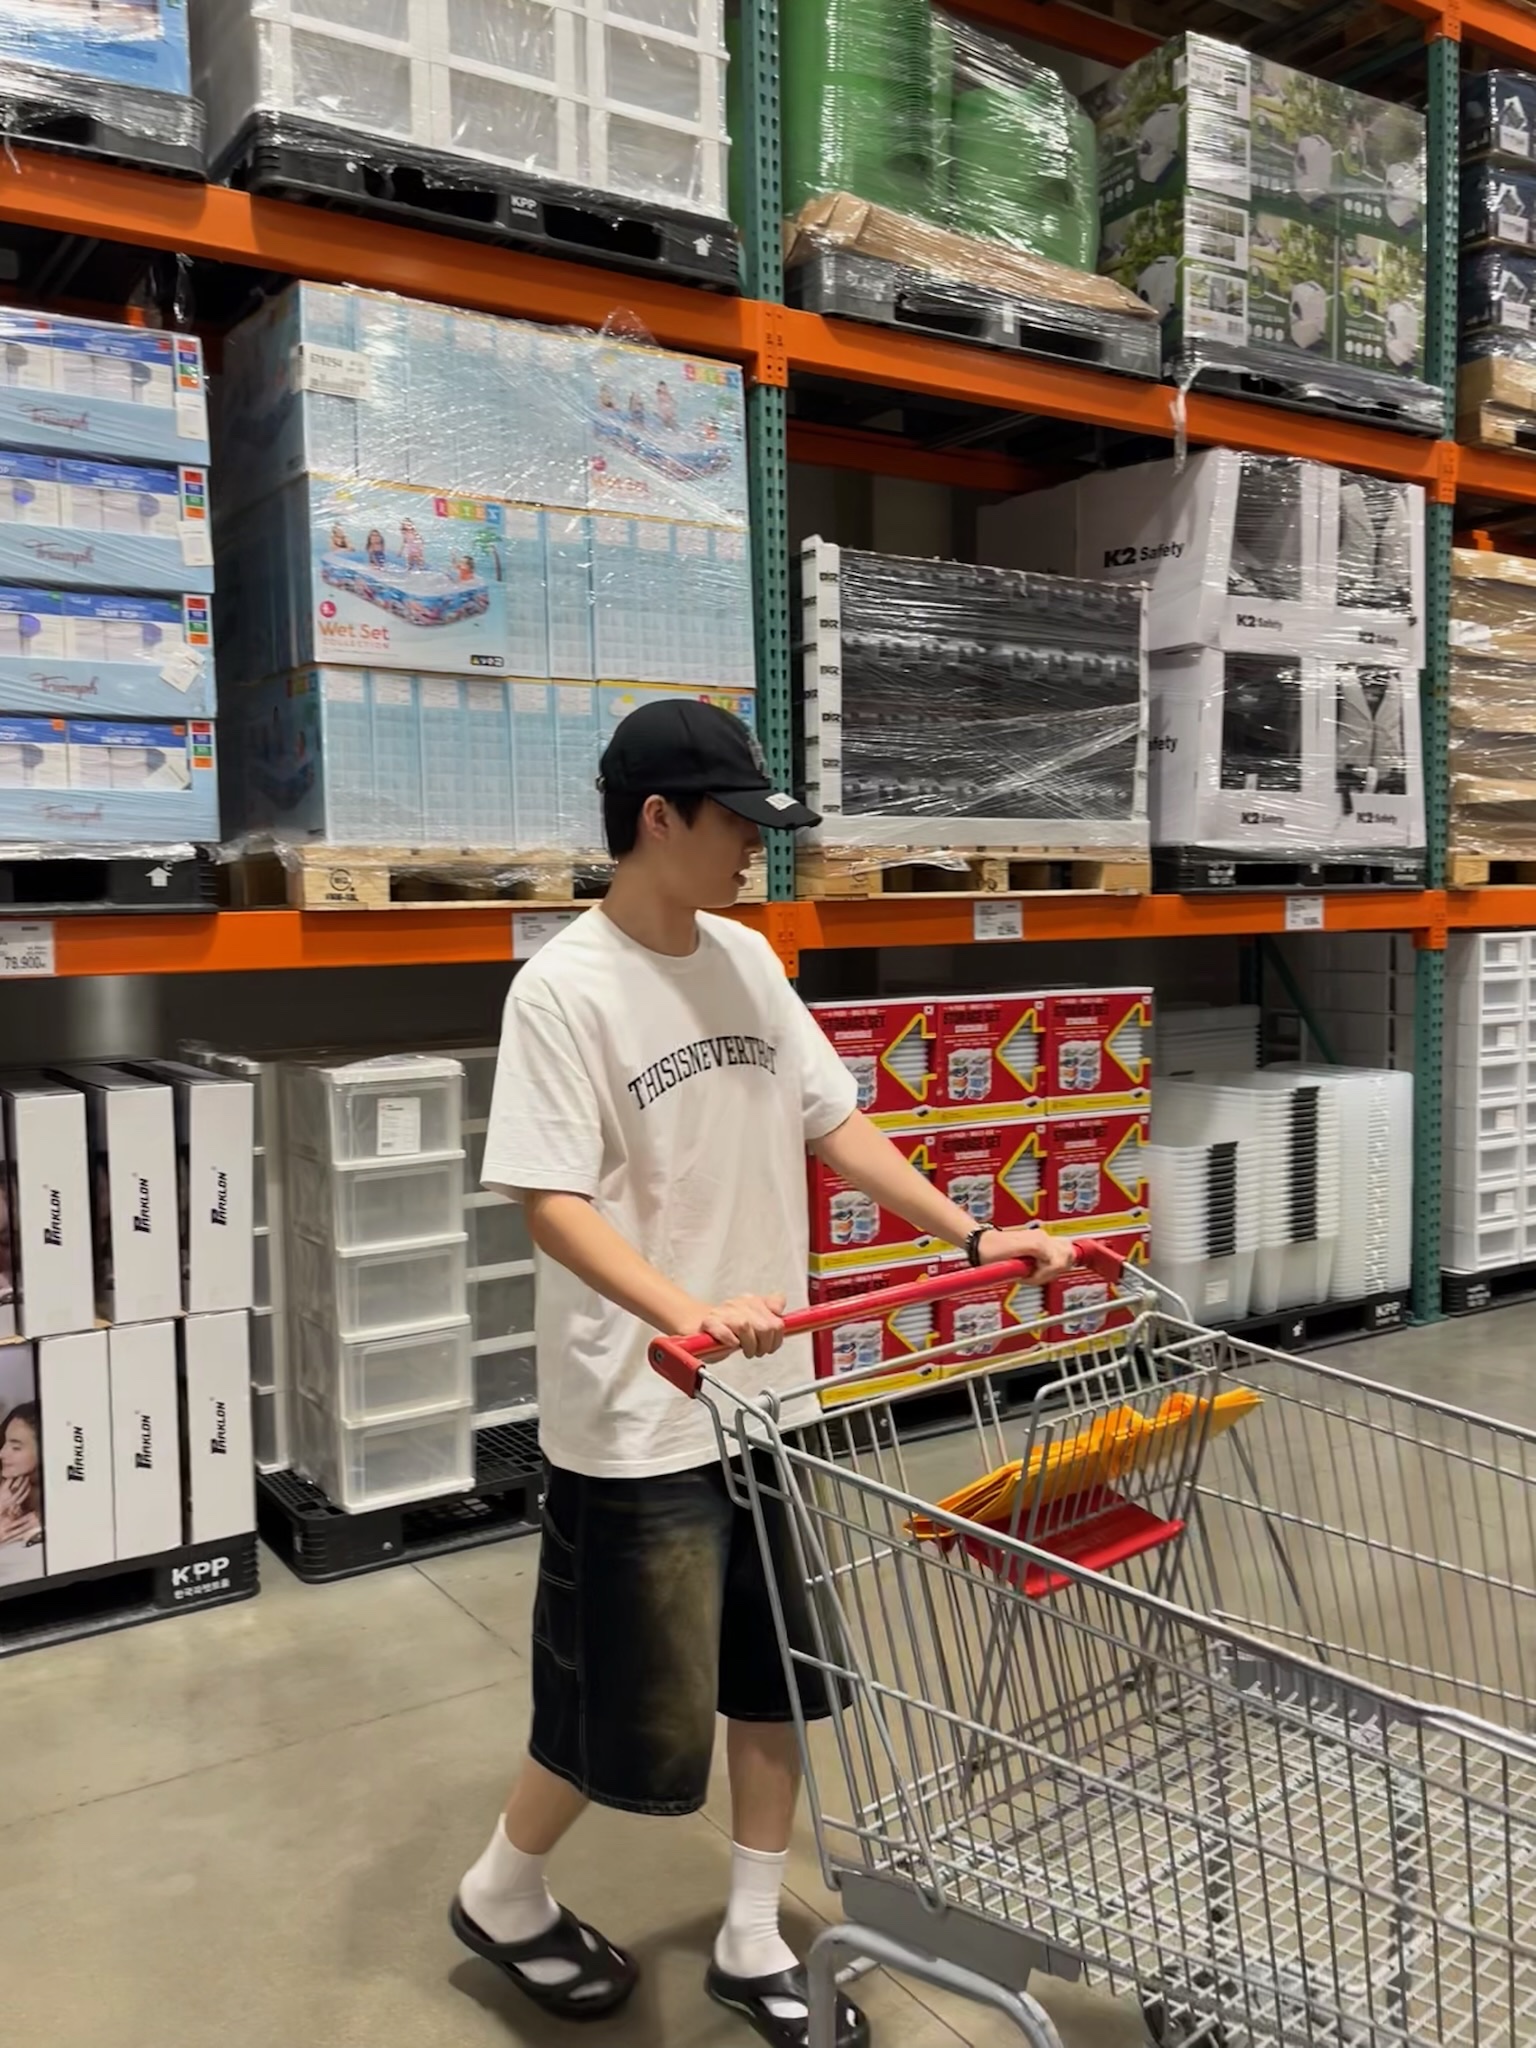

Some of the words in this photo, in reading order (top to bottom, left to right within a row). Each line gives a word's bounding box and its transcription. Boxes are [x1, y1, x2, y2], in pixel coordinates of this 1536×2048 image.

[511, 195, 537, 210] KPP
[1103, 547, 1137, 568] K2
[1140, 541, 1185, 561] Safety
[317, 620, 356, 638] Wet
[360, 623, 391, 641] Set
[1236, 614, 1256, 628] K2
[1241, 812, 1260, 825] K2
[1356, 812, 1374, 824] K2
[133, 1178, 151, 1233] PARKLON
[211, 1171, 228, 1226] PARKLON
[45, 1189, 62, 1246] PARKLON
[1375, 1301, 1401, 1318] KPP
[135, 1415, 152, 1470] PARKLON
[210, 1401, 227, 1455] PARKLON
[67, 1426, 85, 1482] PARKLON
[171, 1556, 231, 1587] KPP
